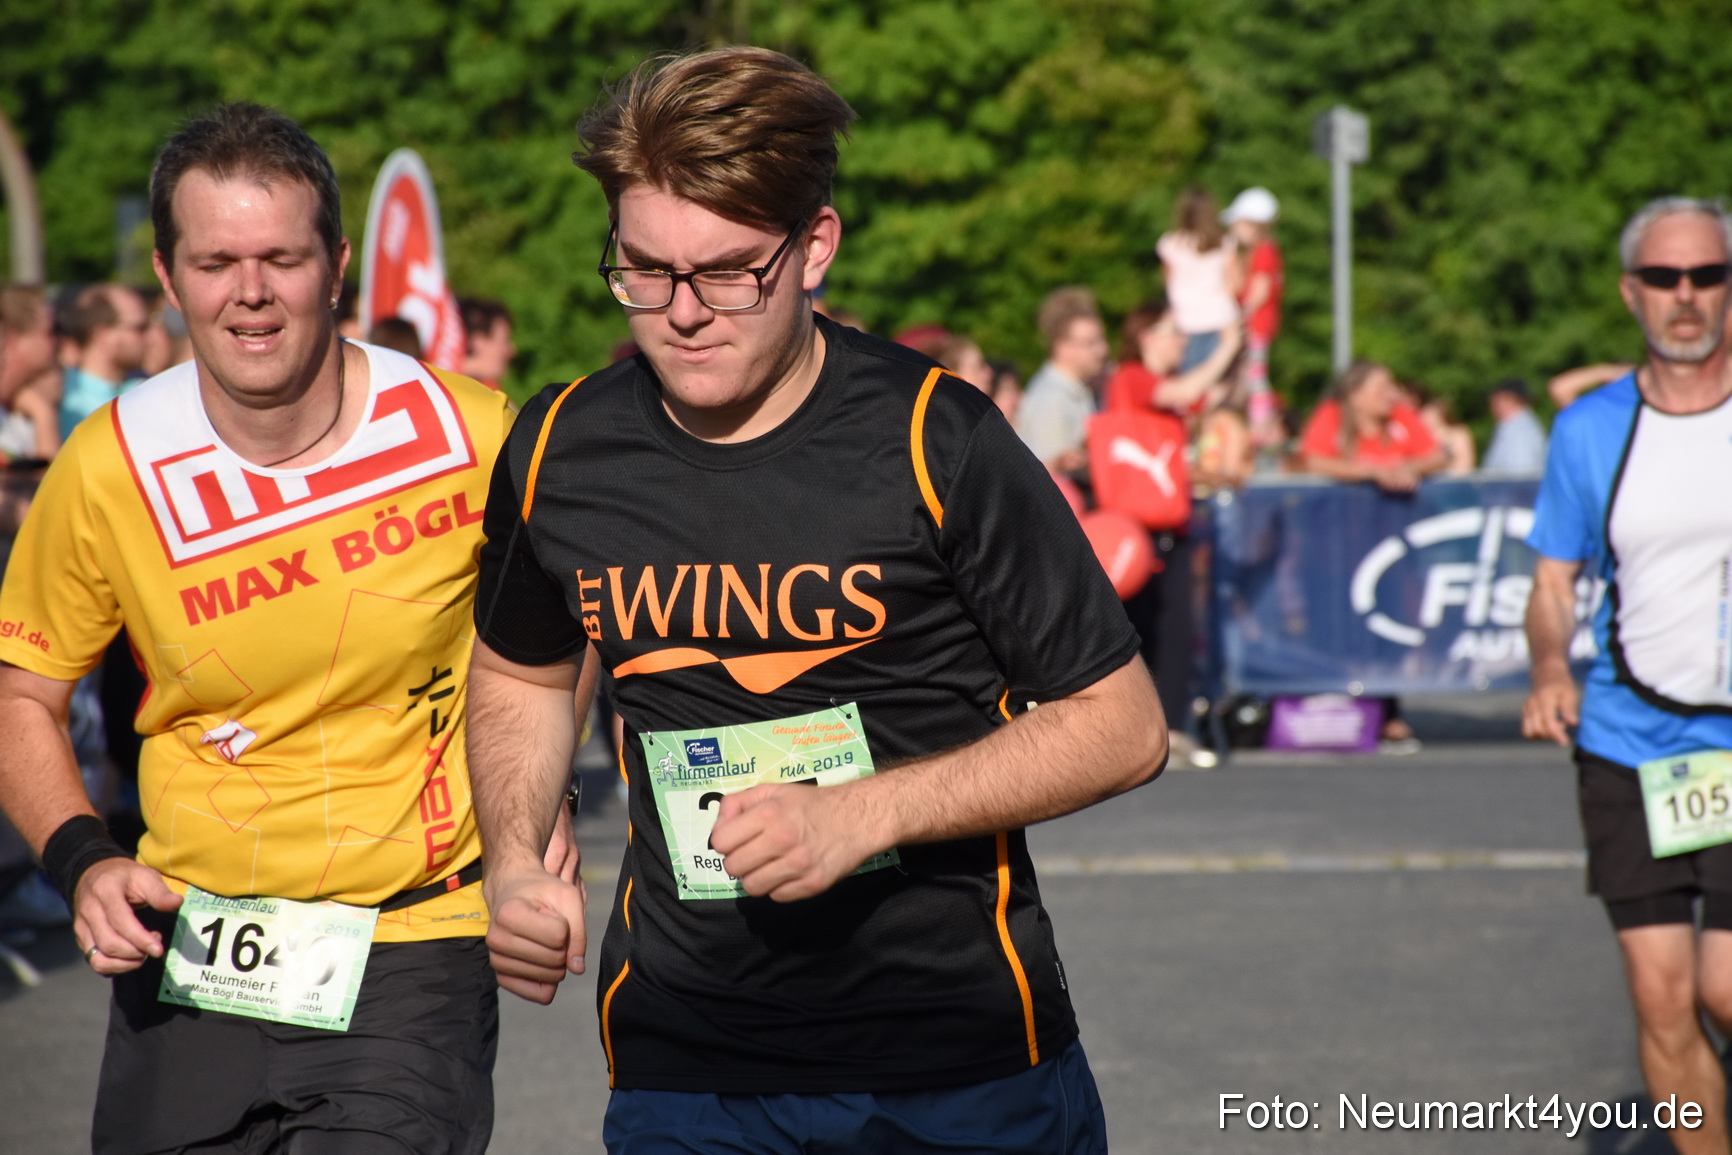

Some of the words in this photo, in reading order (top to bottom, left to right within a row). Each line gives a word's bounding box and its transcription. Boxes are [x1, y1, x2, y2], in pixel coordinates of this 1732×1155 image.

[179, 548, 320, 627] MAX
[332, 491, 485, 574] BÖGL
[576, 569, 603, 642] BIT
[606, 563, 887, 642] WINGS
[0, 617, 50, 653] gl.de
[678, 756, 756, 780] firmenlauf
[780, 762, 807, 779] run
[813, 751, 855, 773] 2019
[680, 779, 713, 787] neumarkt
[190, 983, 210, 995] Max
[212, 987, 234, 1001] Bögl
[200, 969, 266, 993] Neumeier
